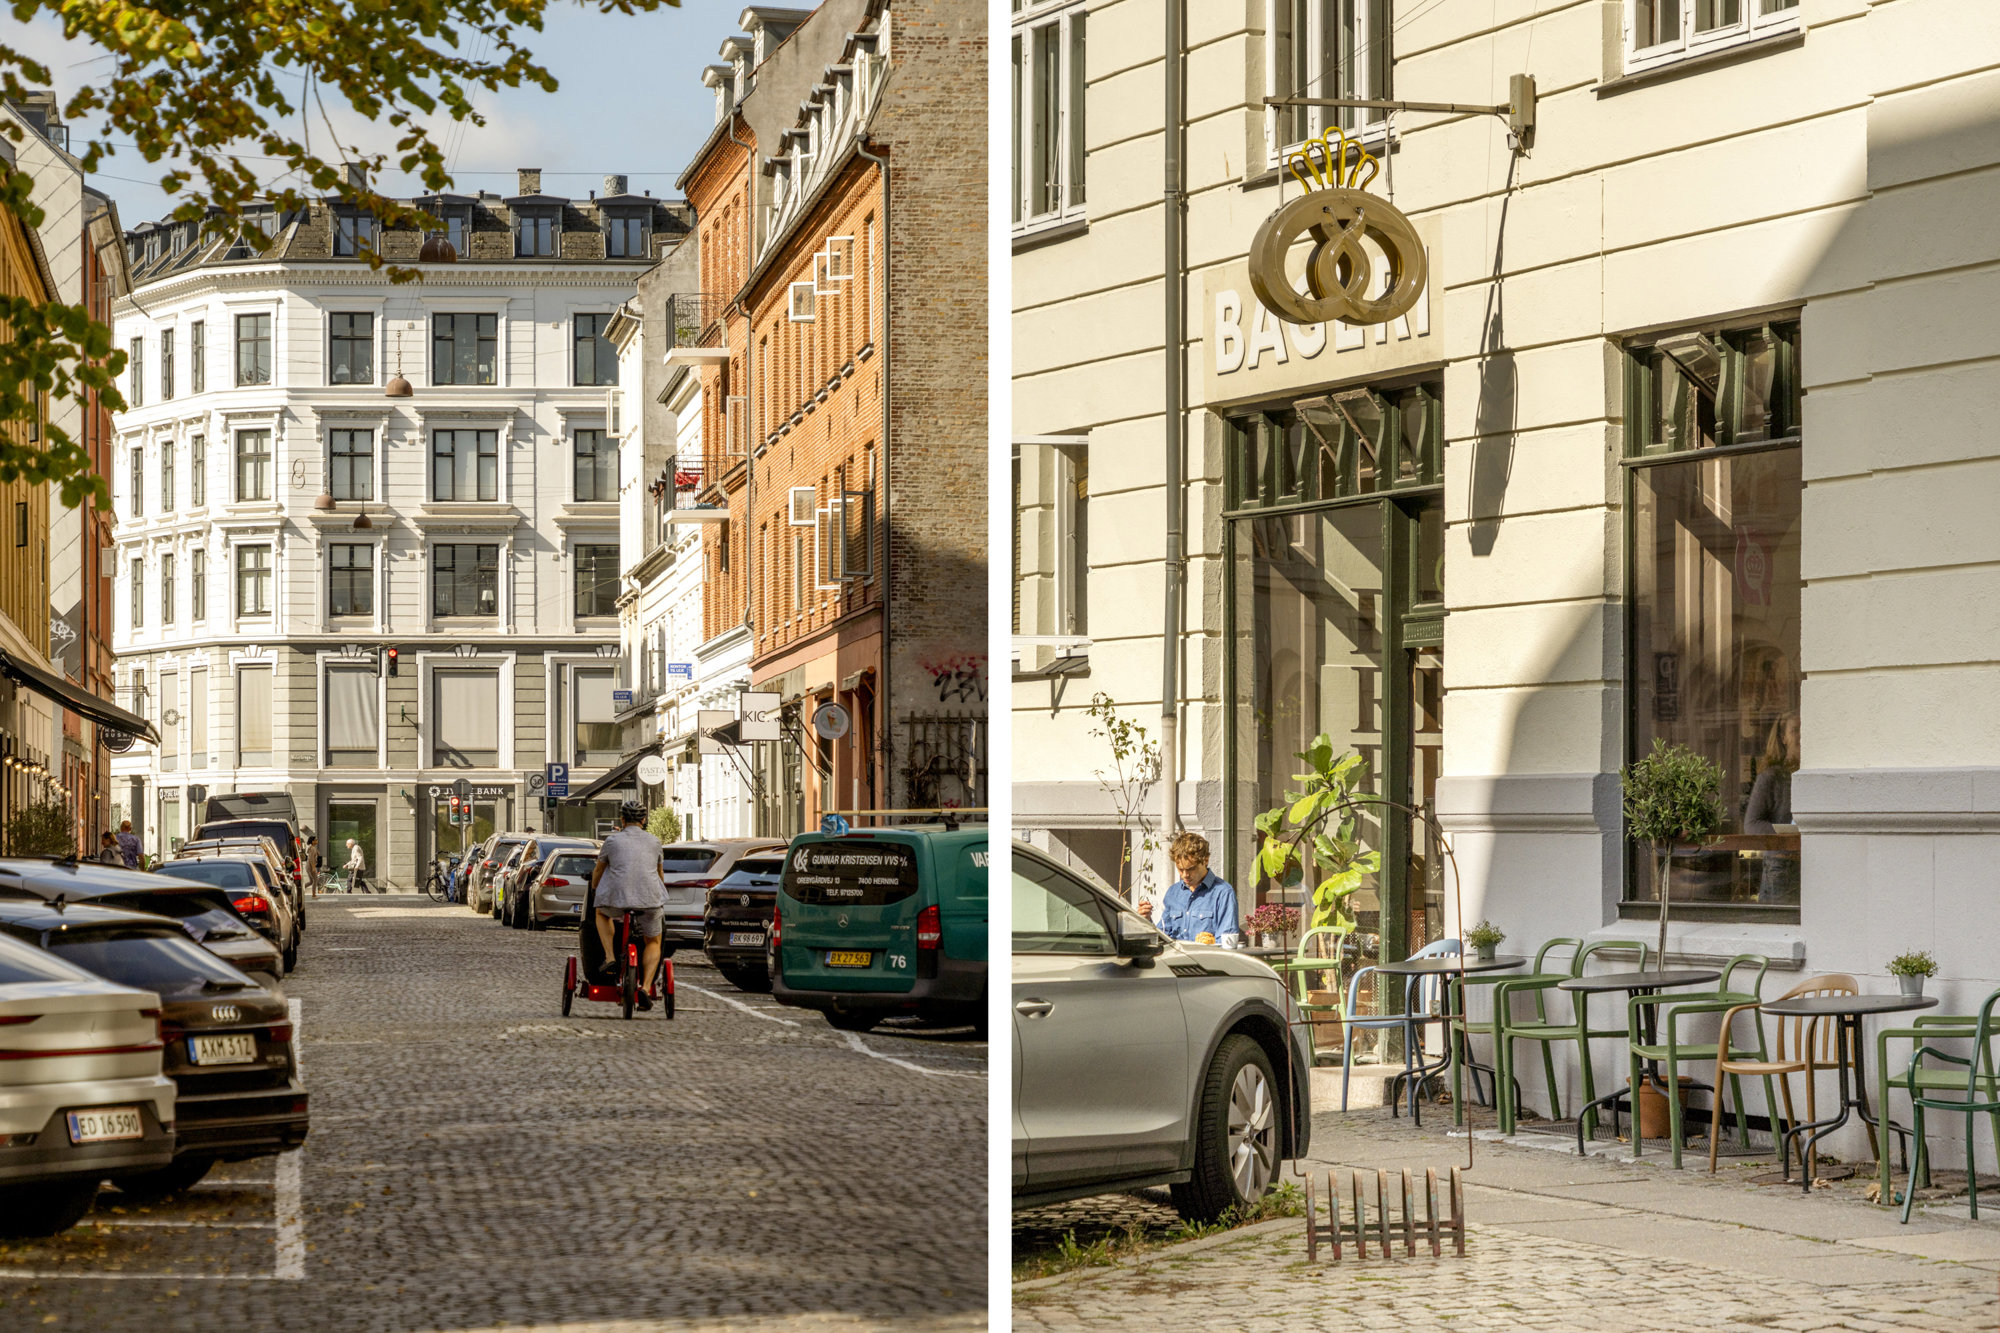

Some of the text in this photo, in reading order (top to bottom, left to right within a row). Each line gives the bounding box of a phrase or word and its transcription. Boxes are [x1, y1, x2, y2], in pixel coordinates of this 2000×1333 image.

[551, 765, 564, 782] P
[477, 787, 504, 795] BANK
[686, 767, 694, 810] PASTA
[812, 855, 839, 865] GUNNAR
[840, 855, 882, 866] KRISTENSEN
[884, 855, 899, 866] VVS
[858, 877, 872, 885] 7400
[873, 877, 899, 886] HERNING
[826, 888, 839, 897] TELF.
[751, 934, 764, 943] 697
[831, 952, 870, 964] BX 27 563
[889, 955, 907, 969] 76
[200, 1038, 226, 1058] AXM
[79, 1116, 97, 1136] ED
[116, 1113, 139, 1133] 590
